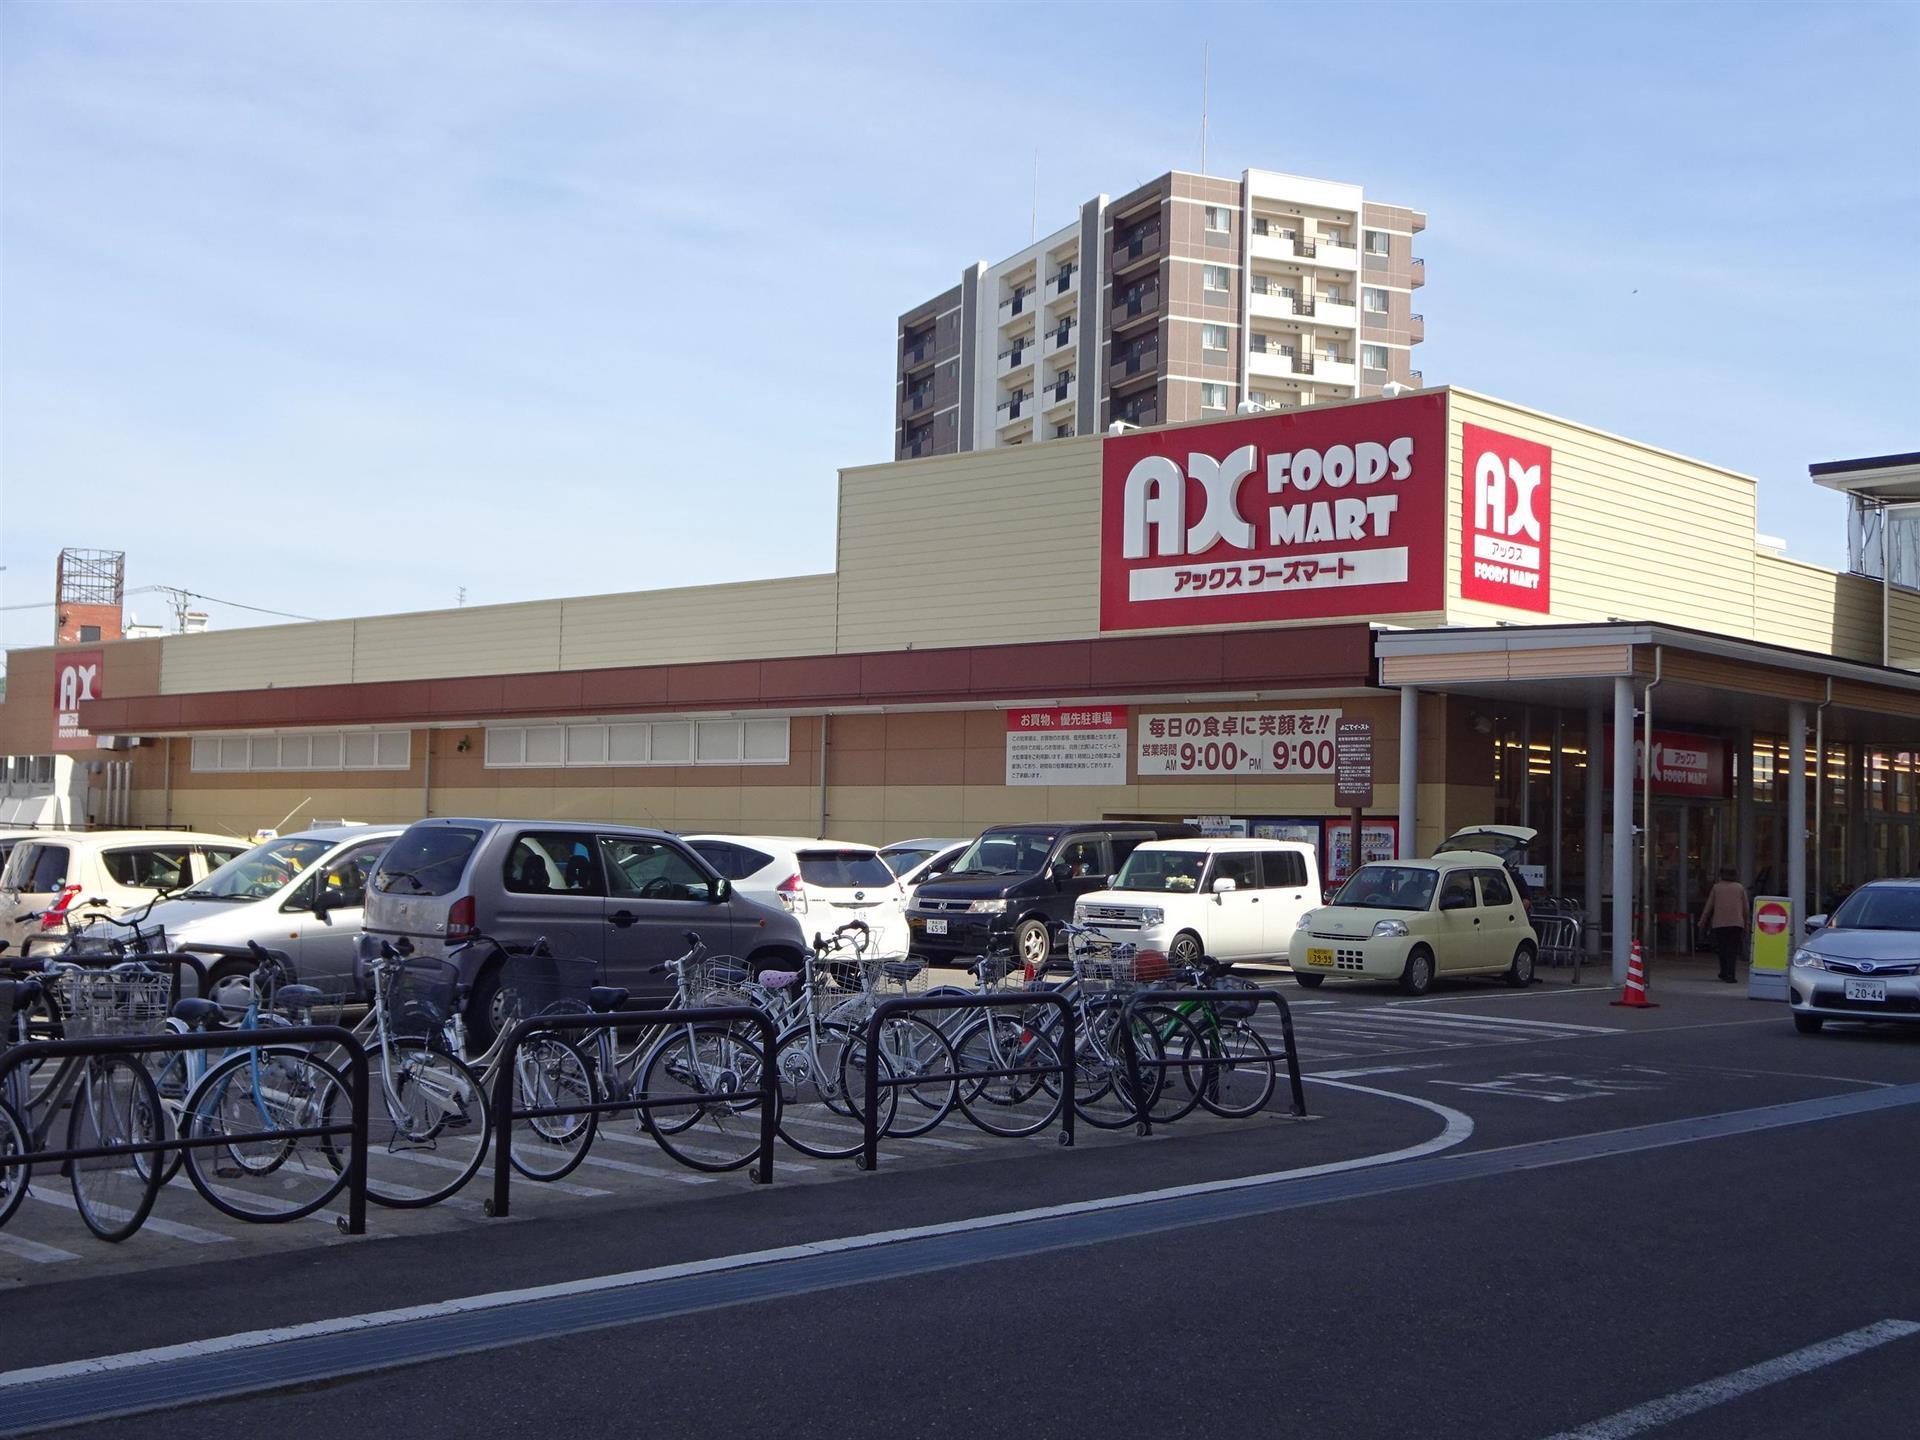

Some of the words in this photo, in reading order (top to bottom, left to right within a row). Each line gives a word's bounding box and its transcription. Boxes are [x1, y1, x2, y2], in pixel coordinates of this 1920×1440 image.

[1267, 437, 1414, 494] FOODS
[1123, 444, 1258, 559] AX
[1474, 451, 1541, 542] AX
[1269, 494, 1399, 547] MART
[1491, 542, 1524, 561] アックス
[1174, 566, 1242, 593] アックス
[1248, 557, 1356, 586] フーズマート
[1474, 561, 1509, 585] FOODS
[1509, 568, 1540, 589] MART
[1142, 743, 1178, 757] 営業時間
[1165, 759, 1177, 771] AM
[1180, 742, 1238, 771] 9:00
[1249, 758, 1262, 770] PM
[1272, 739, 1335, 770] 9:00
[1855, 989, 1883, 1000] 20-44
